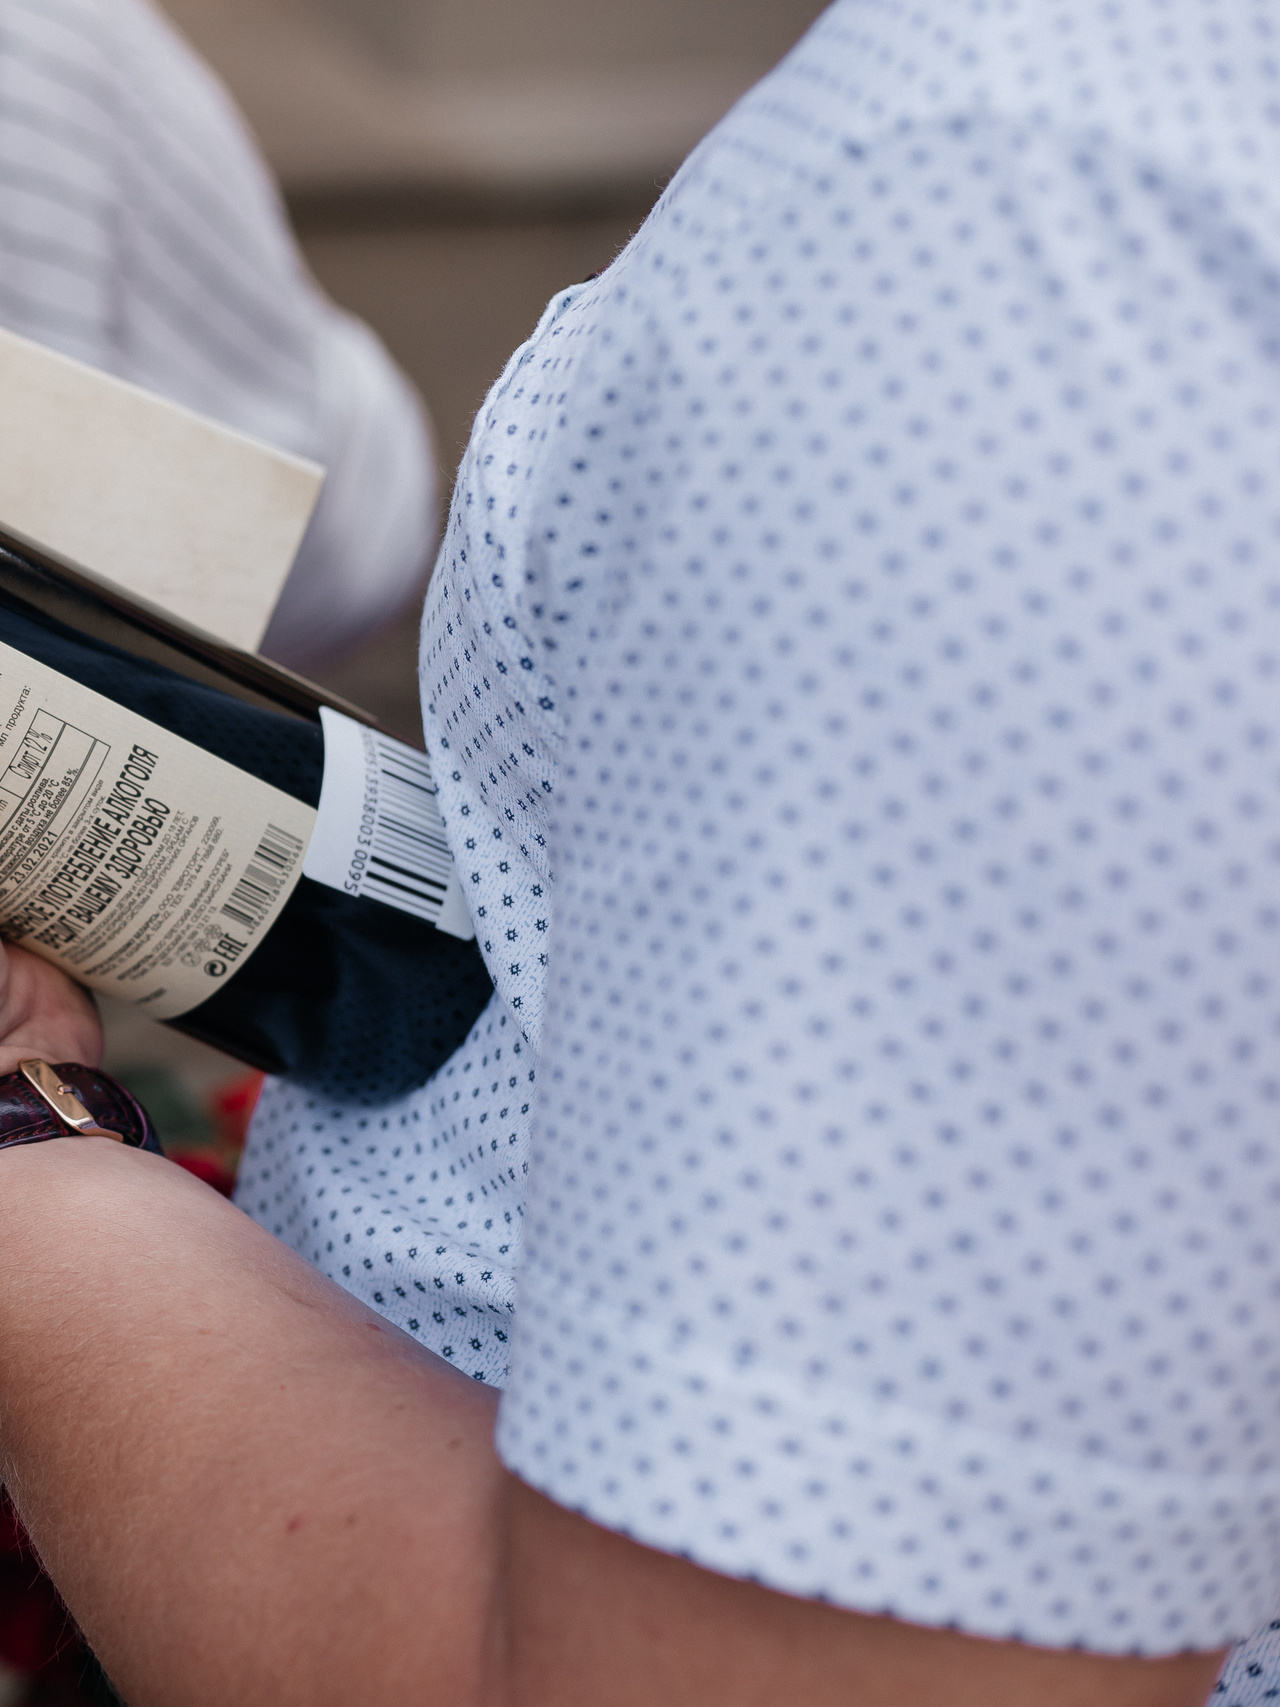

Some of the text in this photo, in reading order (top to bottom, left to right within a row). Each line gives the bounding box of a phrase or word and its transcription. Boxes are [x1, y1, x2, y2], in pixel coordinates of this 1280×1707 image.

[5, 684, 31, 730] продукта:
[7, 724, 53, 781] Спирт 12 %
[61, 775, 72, 787] 85
[91, 778, 104, 796] виде
[14, 806, 30, 826] даты
[26, 775, 50, 808] розлива.
[41, 788, 53, 800] 20
[47, 786, 67, 809] более
[37, 798, 48, 810] до
[26, 817, 35, 825] 5
[43, 808, 53, 819] не
[22, 823, 31, 833] от
[34, 817, 121, 911] УПОТРЕБЛЕНИЕ
[102, 744, 158, 825] АЛКОГОЛЯ
[9, 829, 57, 884] 23.02.2021
[65, 870, 121, 924] ВАШЕМУ
[104, 796, 170, 880] ЗДОРОВЬЮ
[193, 863, 203, 874] 44
